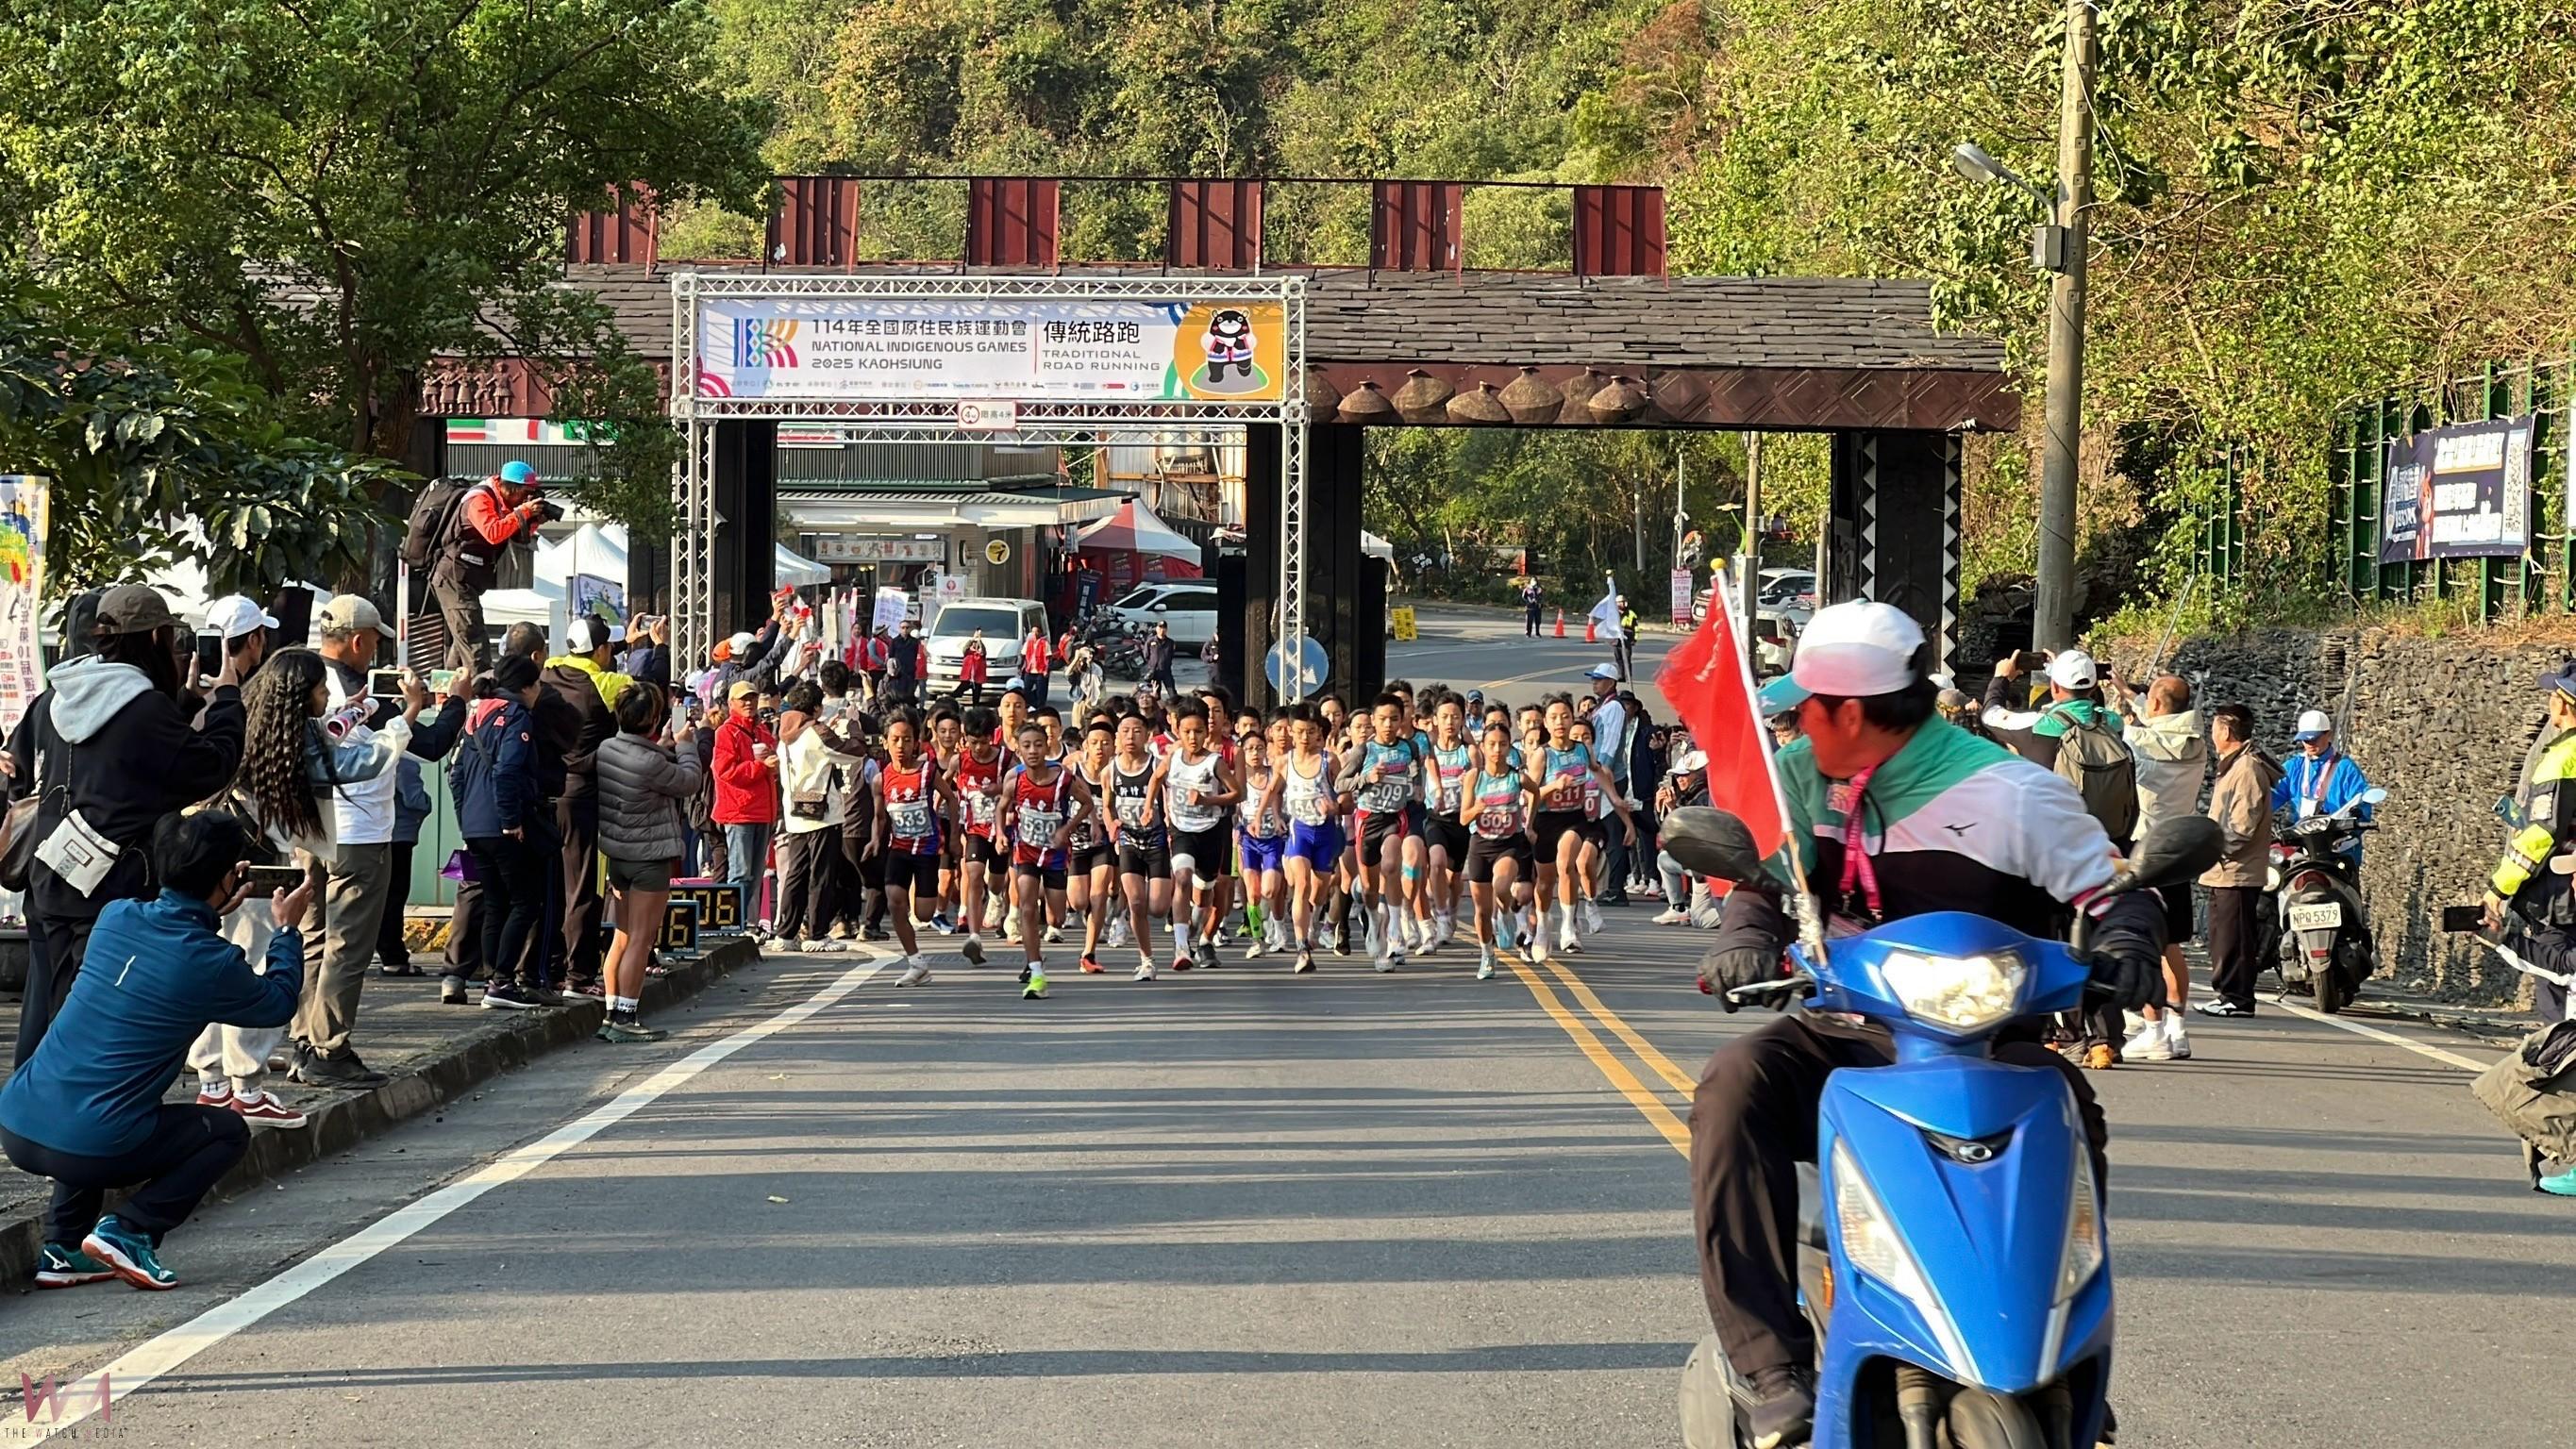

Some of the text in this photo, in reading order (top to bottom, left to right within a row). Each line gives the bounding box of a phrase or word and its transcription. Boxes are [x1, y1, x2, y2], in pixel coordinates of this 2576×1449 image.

[812, 319, 1027, 336] 114年全國原住民族運動會
[1044, 320, 1140, 344] 傳統路跑
[812, 341, 1027, 352] NATIONAL INDIGENOUS GAMES
[1043, 350, 1141, 358] TRADITIONAL
[812, 358, 943, 369] 2025 KAOHSIUNG
[1044, 361, 1160, 371] ROAD RUNNING
[1371, 783, 1402, 801] 509
[1552, 787, 1581, 802] 611
[895, 808, 926, 827] 533
[1480, 813, 1513, 828] 609
[1024, 815, 1057, 836] 530
[2313, 909, 2338, 923] 5379
